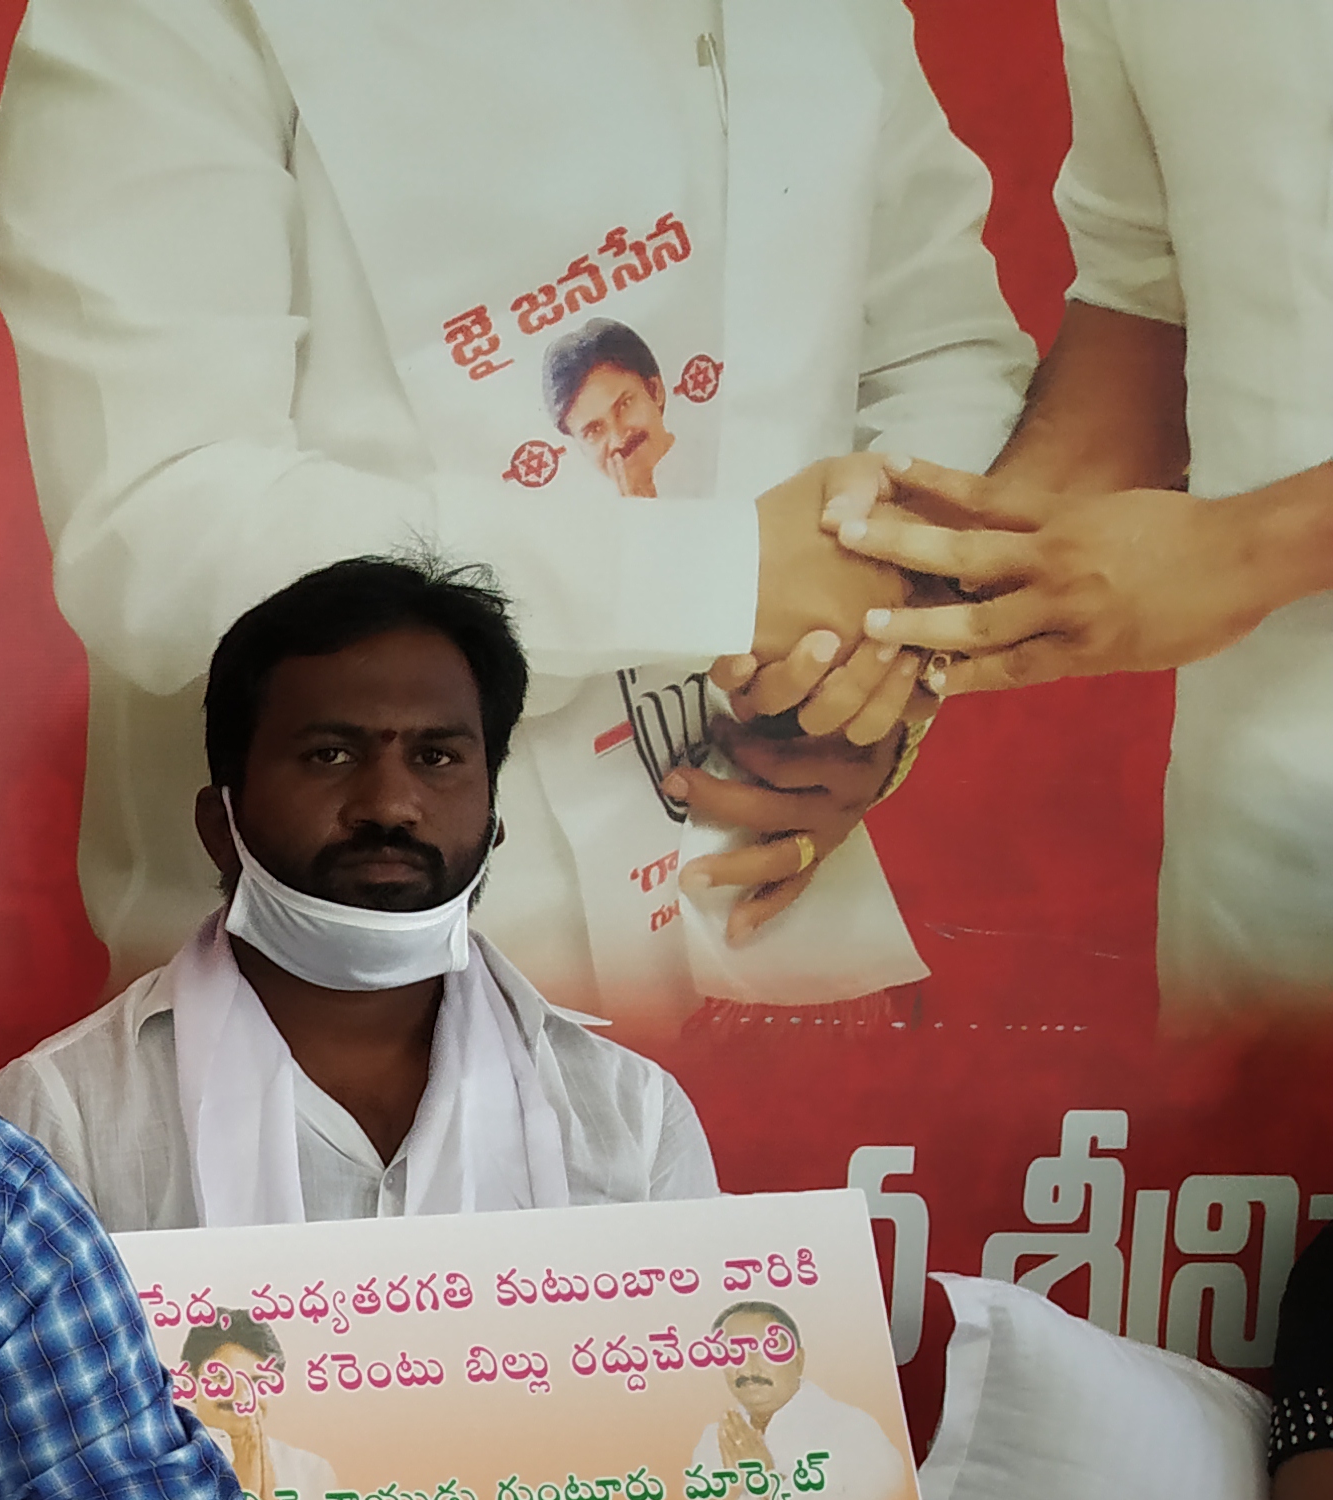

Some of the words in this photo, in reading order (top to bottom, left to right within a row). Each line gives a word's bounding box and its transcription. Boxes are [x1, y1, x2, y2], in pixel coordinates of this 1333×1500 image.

[443, 304, 515, 381] జై
[510, 211, 692, 336] జనసేన
[138, 1283, 231, 1328] పేద,
[251, 1273, 474, 1334] మధ్యతరగతి
[496, 1268, 700, 1306] కుటుంబాల
[723, 1248, 818, 1291] వారికి
[171, 1357, 285, 1414] వచ్చిన
[307, 1352, 444, 1391] కరెంటు
[465, 1346, 551, 1393] బిల్లు
[571, 1326, 796, 1391] రద్దుచేయాలి
